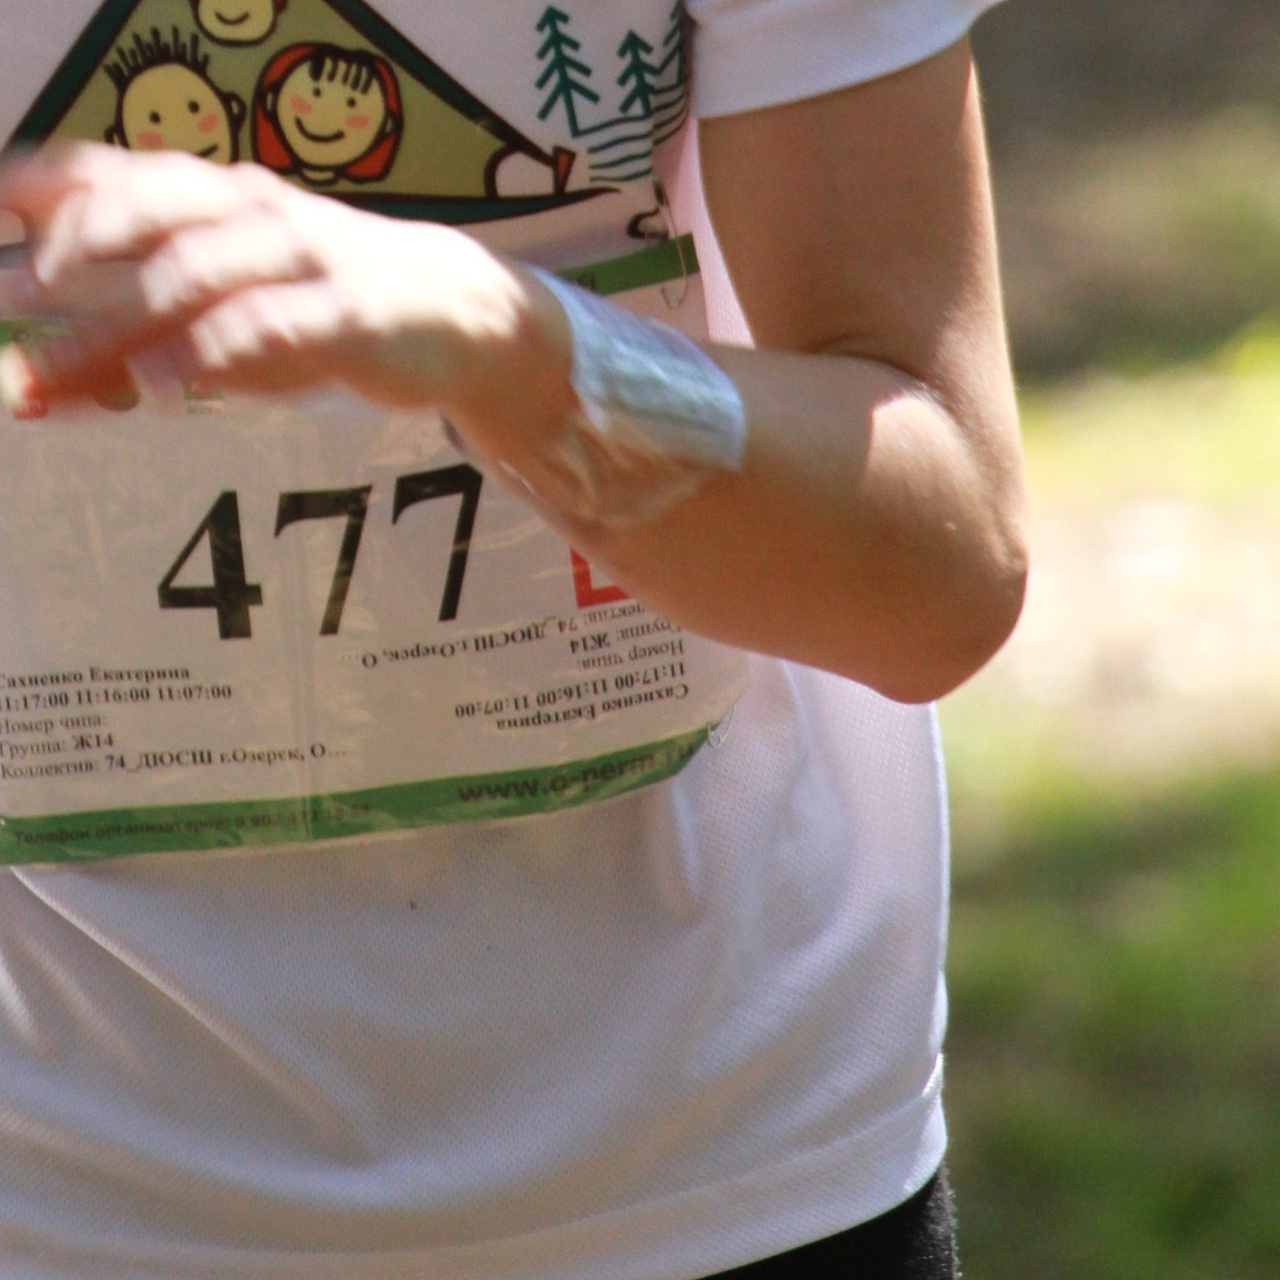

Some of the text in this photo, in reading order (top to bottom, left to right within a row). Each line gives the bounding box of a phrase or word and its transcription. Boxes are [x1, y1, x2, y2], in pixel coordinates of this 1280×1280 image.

[157, 462, 483, 639] 477
[570, 632, 610, 654] Ж14
[577, 639, 685, 670] Номер чипа:
[89, 666, 191, 684] Екатерина
[76, 687, 150, 706] 11:16:00
[157, 684, 232, 702] 11:07:00
[454, 662, 686, 718] 11:17:00 11:16:00 11:07:00
[60, 713, 106, 729] чипа:
[496, 705, 596, 730] Екатерина
[74, 733, 115, 751] Ж14
[1, 760, 100, 780] Коллектив:
